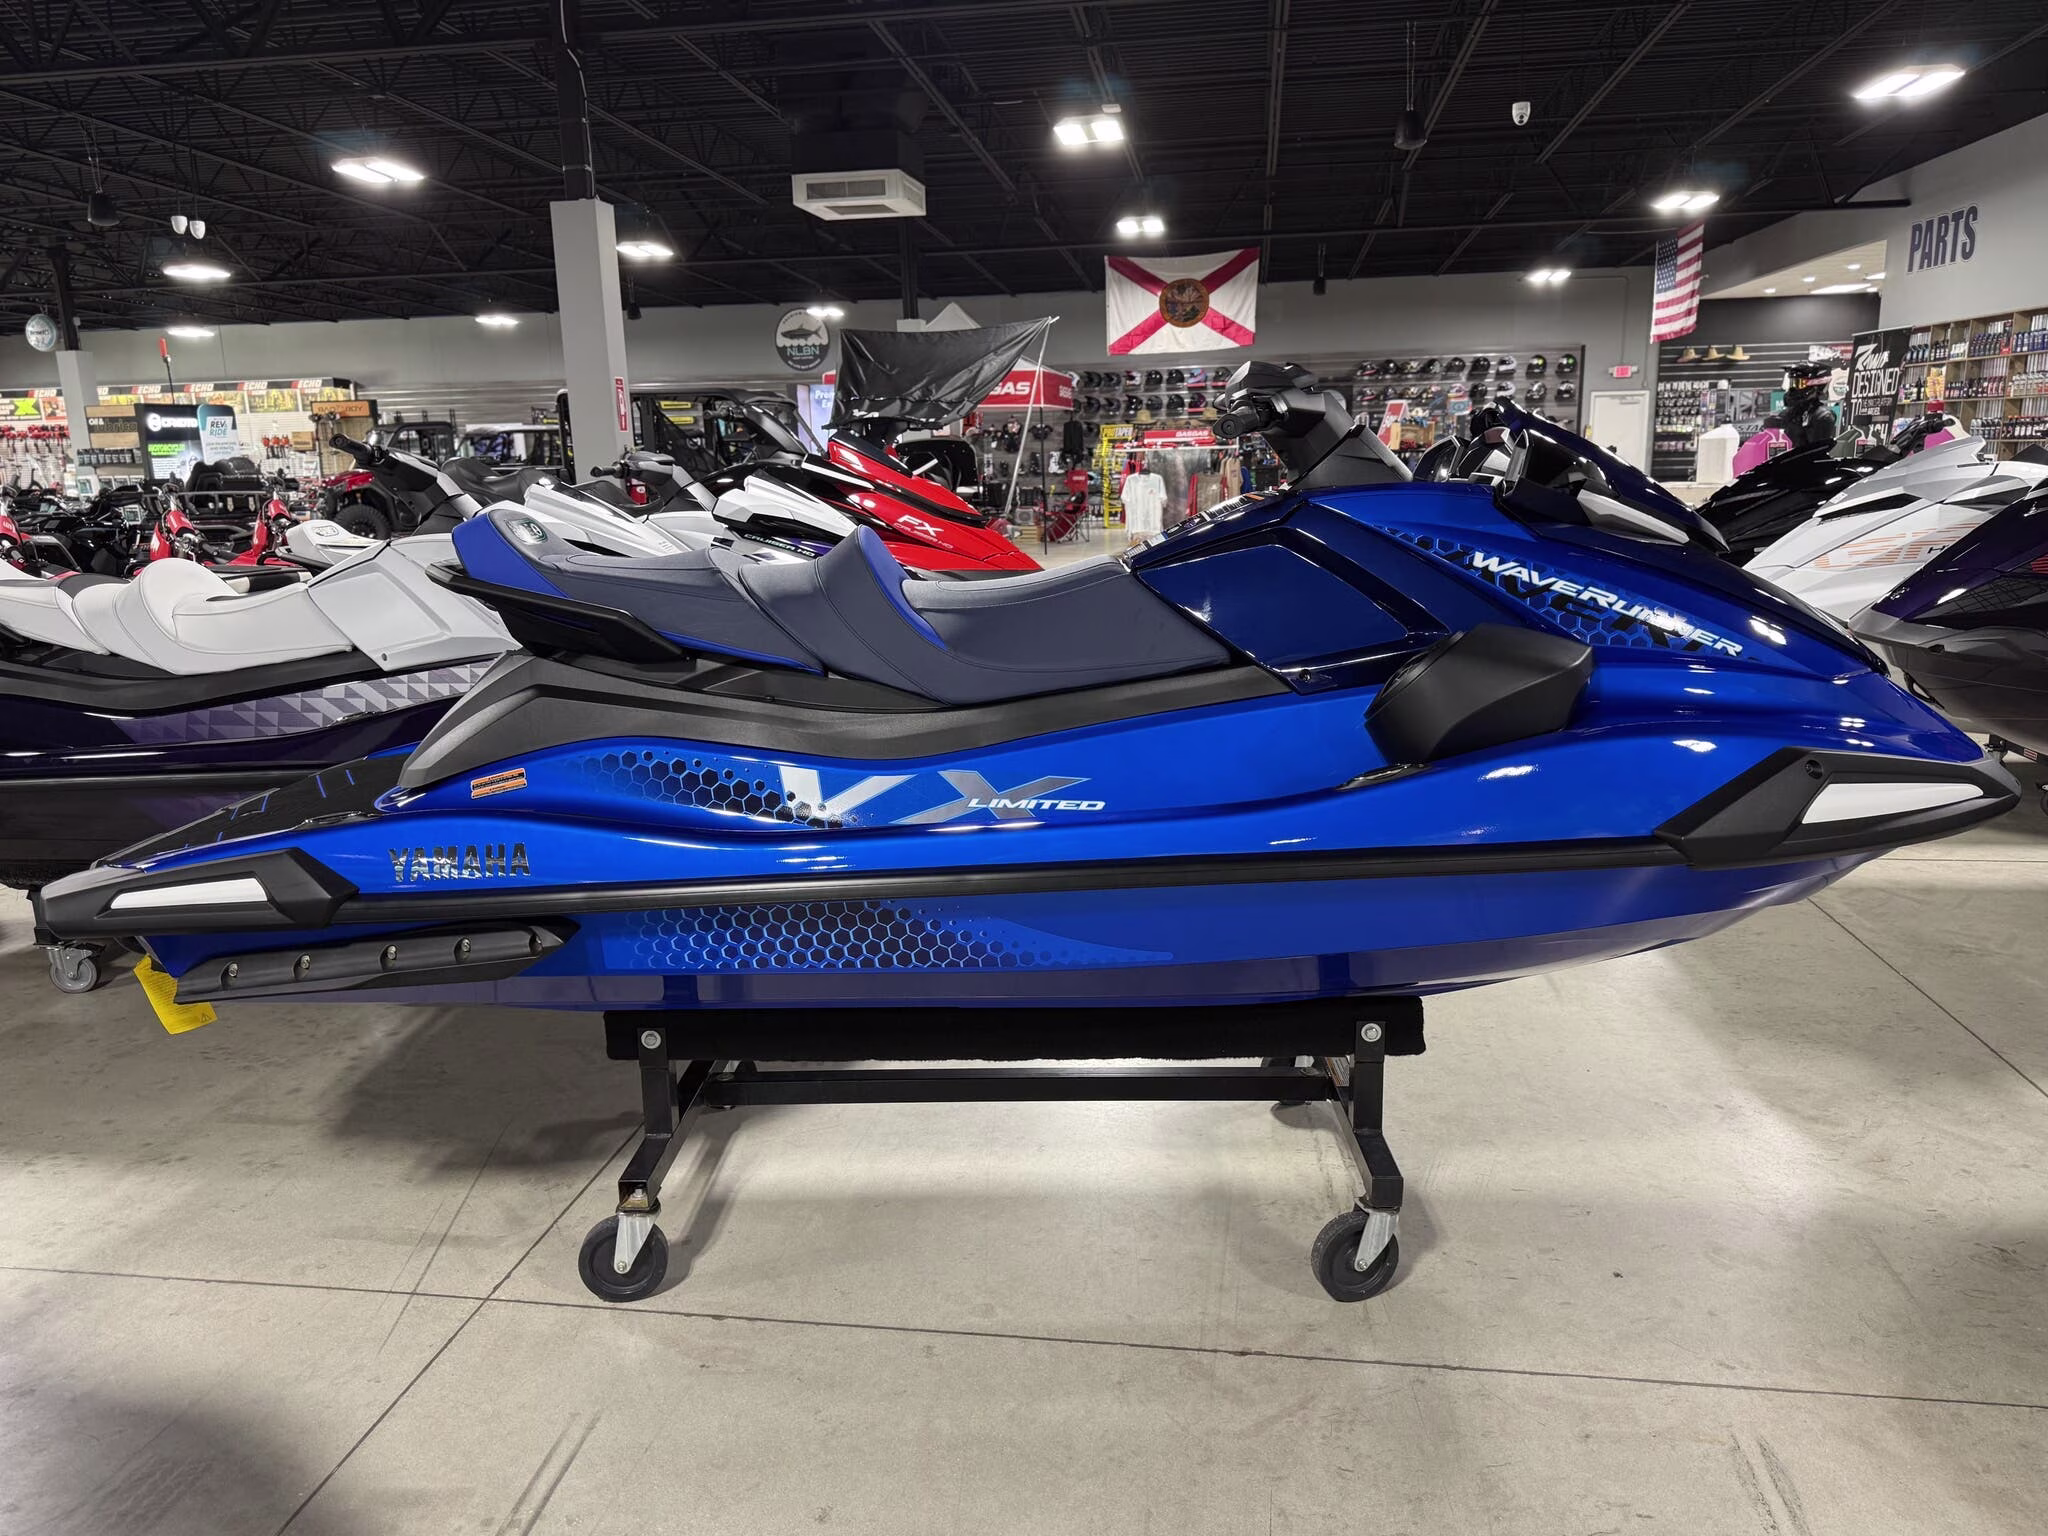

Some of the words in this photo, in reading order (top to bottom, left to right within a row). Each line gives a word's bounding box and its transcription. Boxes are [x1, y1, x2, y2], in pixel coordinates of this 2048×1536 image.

[1907, 204, 1978, 273] PARTS
[787, 345, 820, 356] NLBN
[190, 384, 214, 392] ECHO
[243, 381, 267, 390] ECHO
[297, 380, 321, 388] ECHO
[1851, 367, 1900, 398] DESIGNED
[138, 386, 162, 394] ECHO
[1176, 430, 1209, 438] GASGAS
[897, 514, 944, 537] FX
[744, 533, 796, 551] CRUISER
[779, 764, 1092, 827] VX
[967, 797, 1106, 811] LIMITED
[388, 841, 530, 882] YAMAHA
